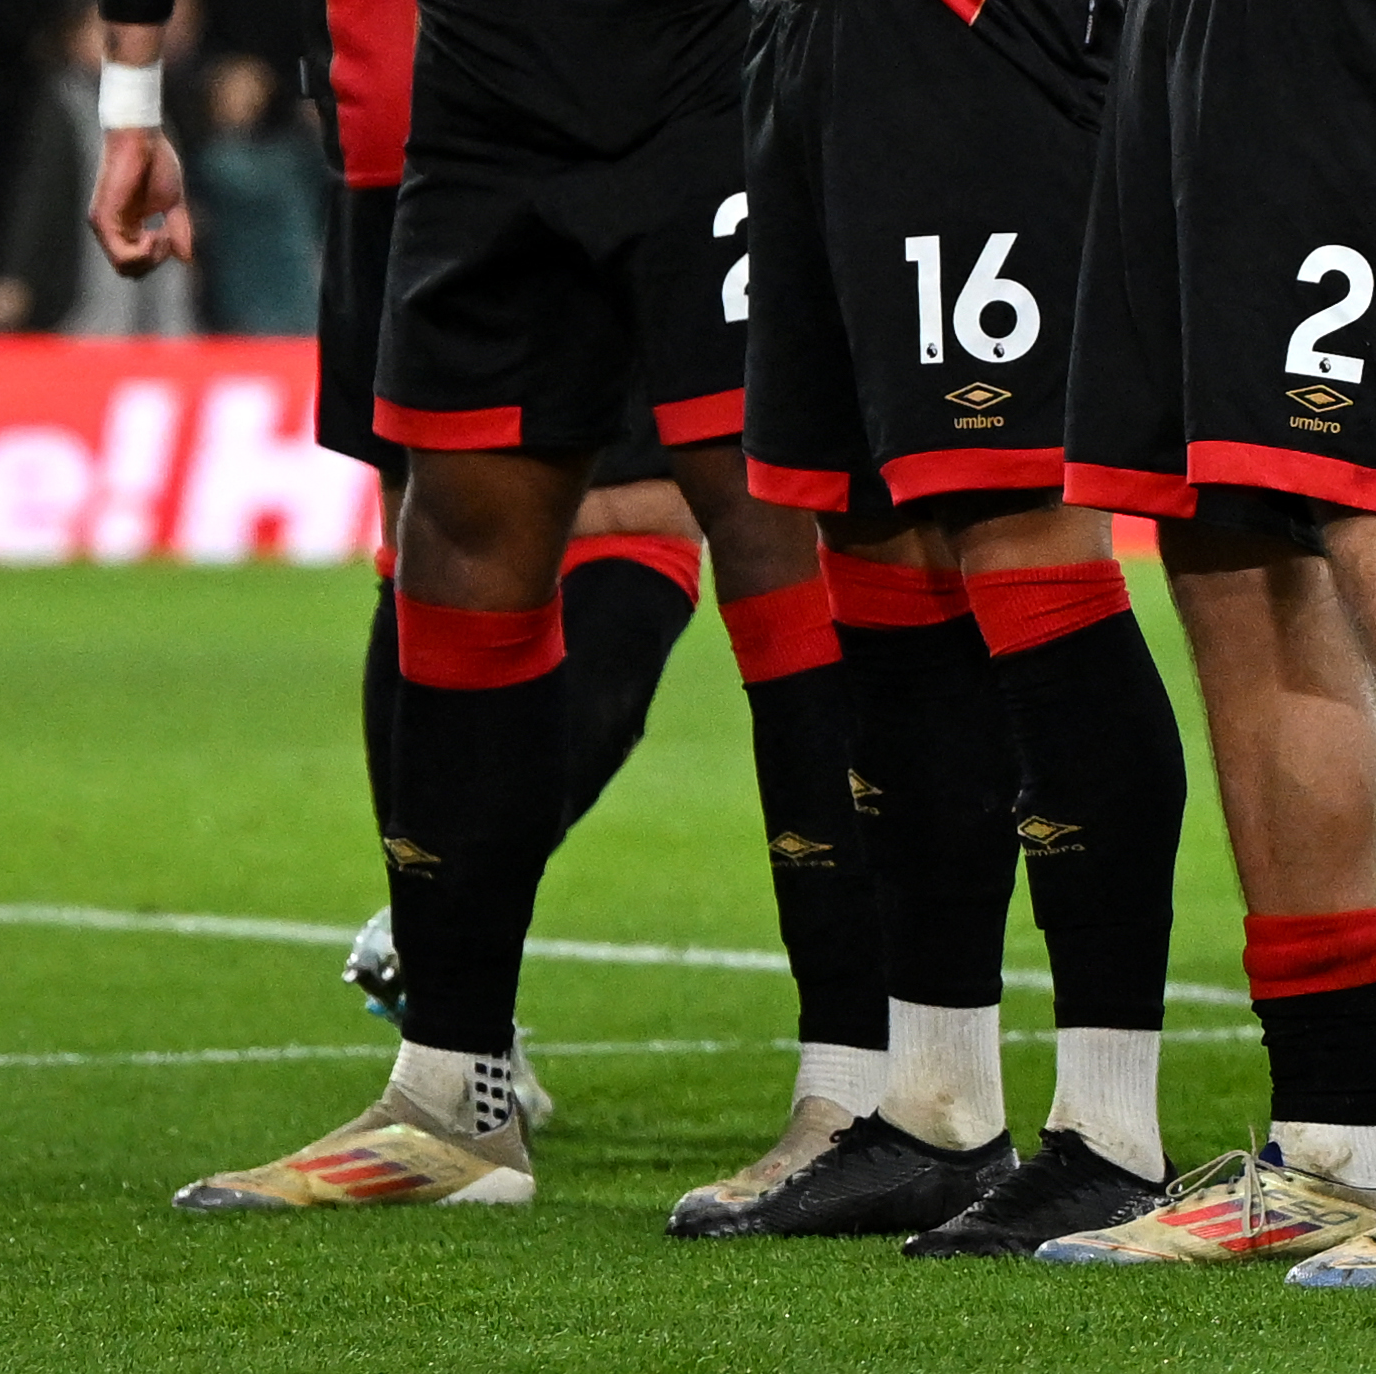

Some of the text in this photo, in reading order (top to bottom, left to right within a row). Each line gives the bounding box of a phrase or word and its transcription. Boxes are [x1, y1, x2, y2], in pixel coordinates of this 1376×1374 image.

[904, 232, 1041, 364] 16
[1284, 244, 1375, 384] 2
[953, 414, 1005, 430] umbro
[1289, 415, 1342, 434] umbro
